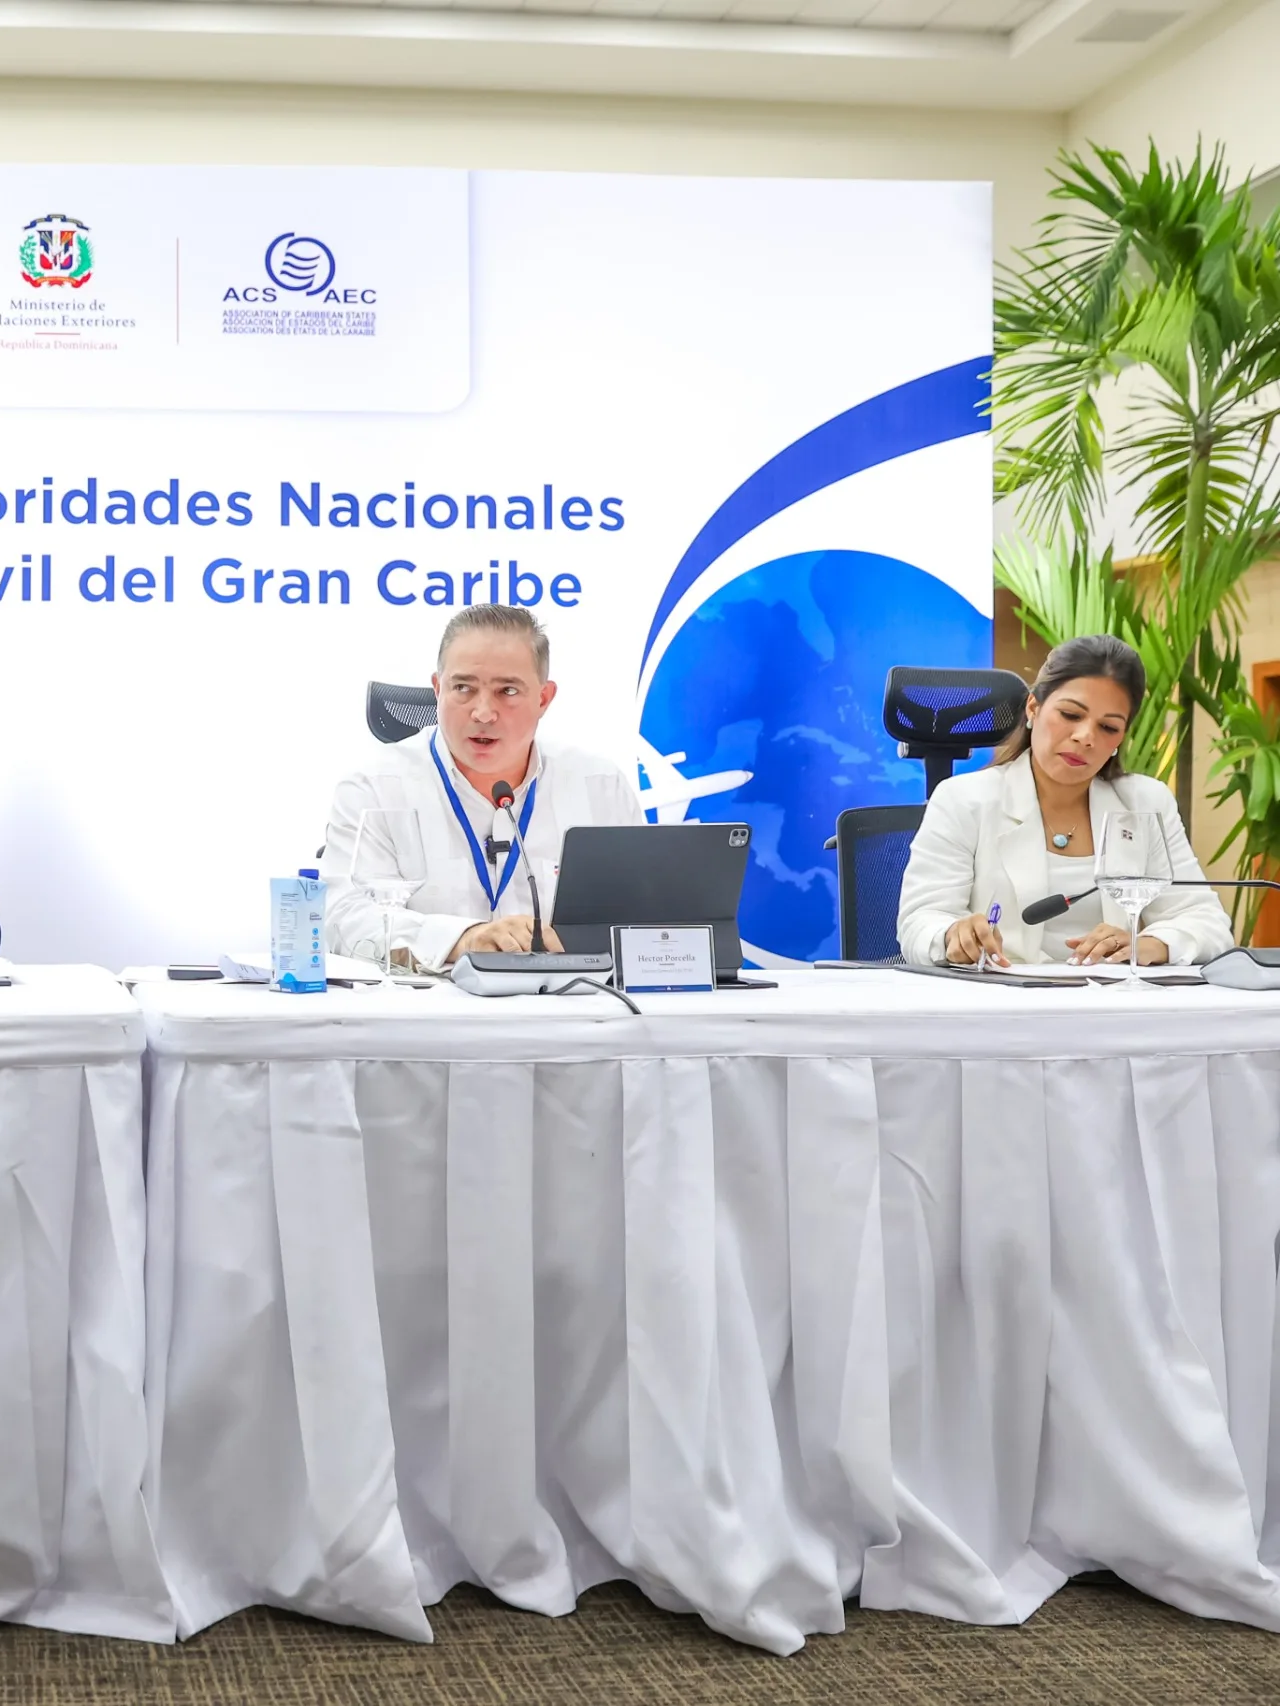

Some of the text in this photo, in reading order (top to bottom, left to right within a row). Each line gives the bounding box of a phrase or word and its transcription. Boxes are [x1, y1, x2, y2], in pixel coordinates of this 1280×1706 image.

[222, 286, 377, 305] ACS AEC
[10, 299, 107, 312] Ministerio de
[61, 315, 137, 328] Exteriores
[222, 310, 377, 321] ASSOCIATION OF CARIBBEAN STATES
[275, 319, 286, 328] DE
[288, 319, 326, 329] ESTADOS
[328, 320, 343, 329] DEL
[345, 320, 376, 329] CARIBE
[222, 327, 274, 336] ASSOCIATION
[275, 327, 293, 336] DES
[318, 329, 329, 337] DE
[330, 329, 341, 337] LA
[54, 340, 118, 350] Dominicana
[280, 481, 625, 532] Nacionales
[78, 554, 175, 603] del
[202, 557, 351, 605] Gran
[376, 559, 582, 607] Caribe
[638, 953, 696, 962] Hector Porcella
